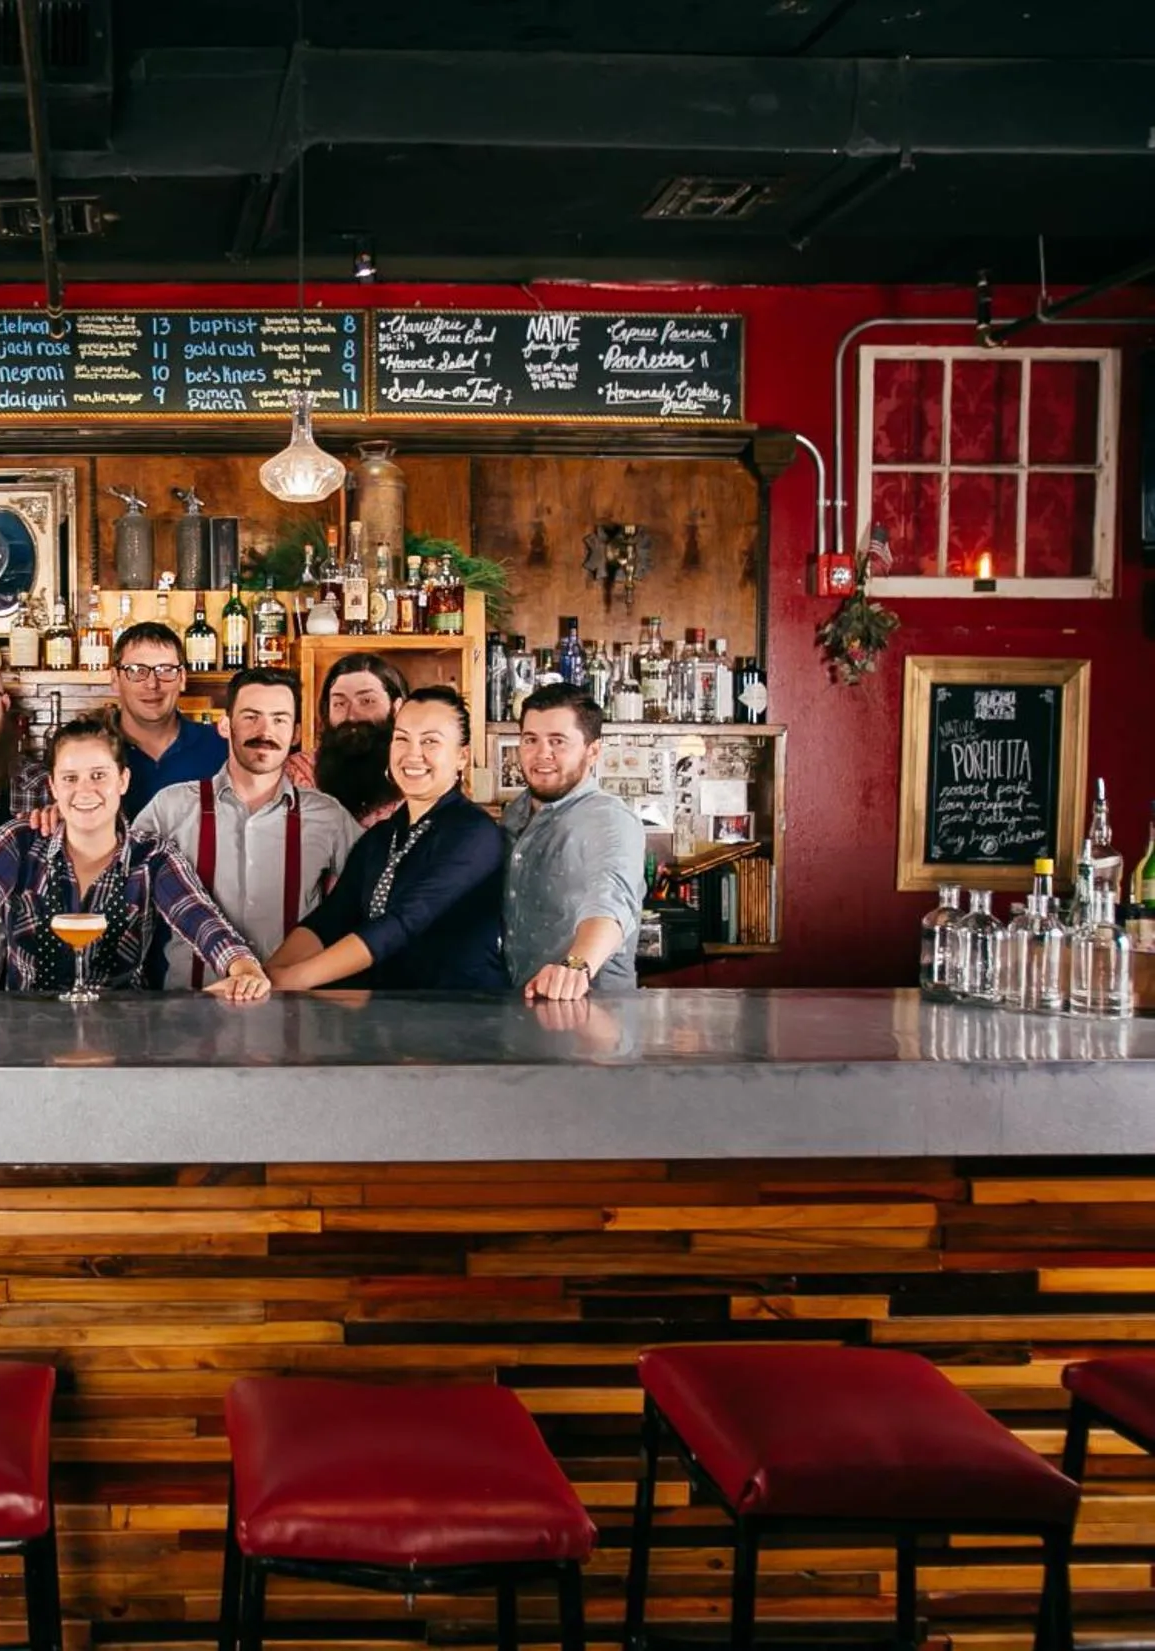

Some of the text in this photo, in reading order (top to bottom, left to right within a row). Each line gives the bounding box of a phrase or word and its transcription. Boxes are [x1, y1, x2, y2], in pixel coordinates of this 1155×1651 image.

[152, 317, 171, 336] 13
[190, 317, 257, 336] baptist
[344, 315, 357, 334] 8
[388, 315, 483, 334] Charcuterie &
[526, 314, 581, 342] NATIVE
[660, 320, 713, 345] Panini
[719, 322, 728, 339] 9
[424, 327, 496, 344] Cheese Board
[36, 342, 71, 356] rose
[153, 342, 167, 359] 11
[184, 341, 256, 359] gold rush
[344, 339, 356, 359] 8
[604, 345, 695, 370] Porchetta
[700, 351, 709, 368] 11
[386, 354, 436, 370] Harvest
[437, 350, 479, 371] Salad
[0, 364, 65, 384] negroni
[152, 366, 170, 381] 10
[185, 365, 266, 384] bee's knees
[342, 363, 356, 382] 9
[153, 386, 166, 404] 9
[188, 388, 243, 400] roman
[344, 388, 357, 409] 11
[466, 377, 502, 403] Toast
[504, 389, 513, 406] 7
[606, 380, 721, 402] Homemade Cracker
[723, 394, 731, 415] 5
[951, 739, 1032, 781] PORCHETTA
[939, 781, 1031, 801] roasted pork
[970, 796, 1023, 812] wrapped
